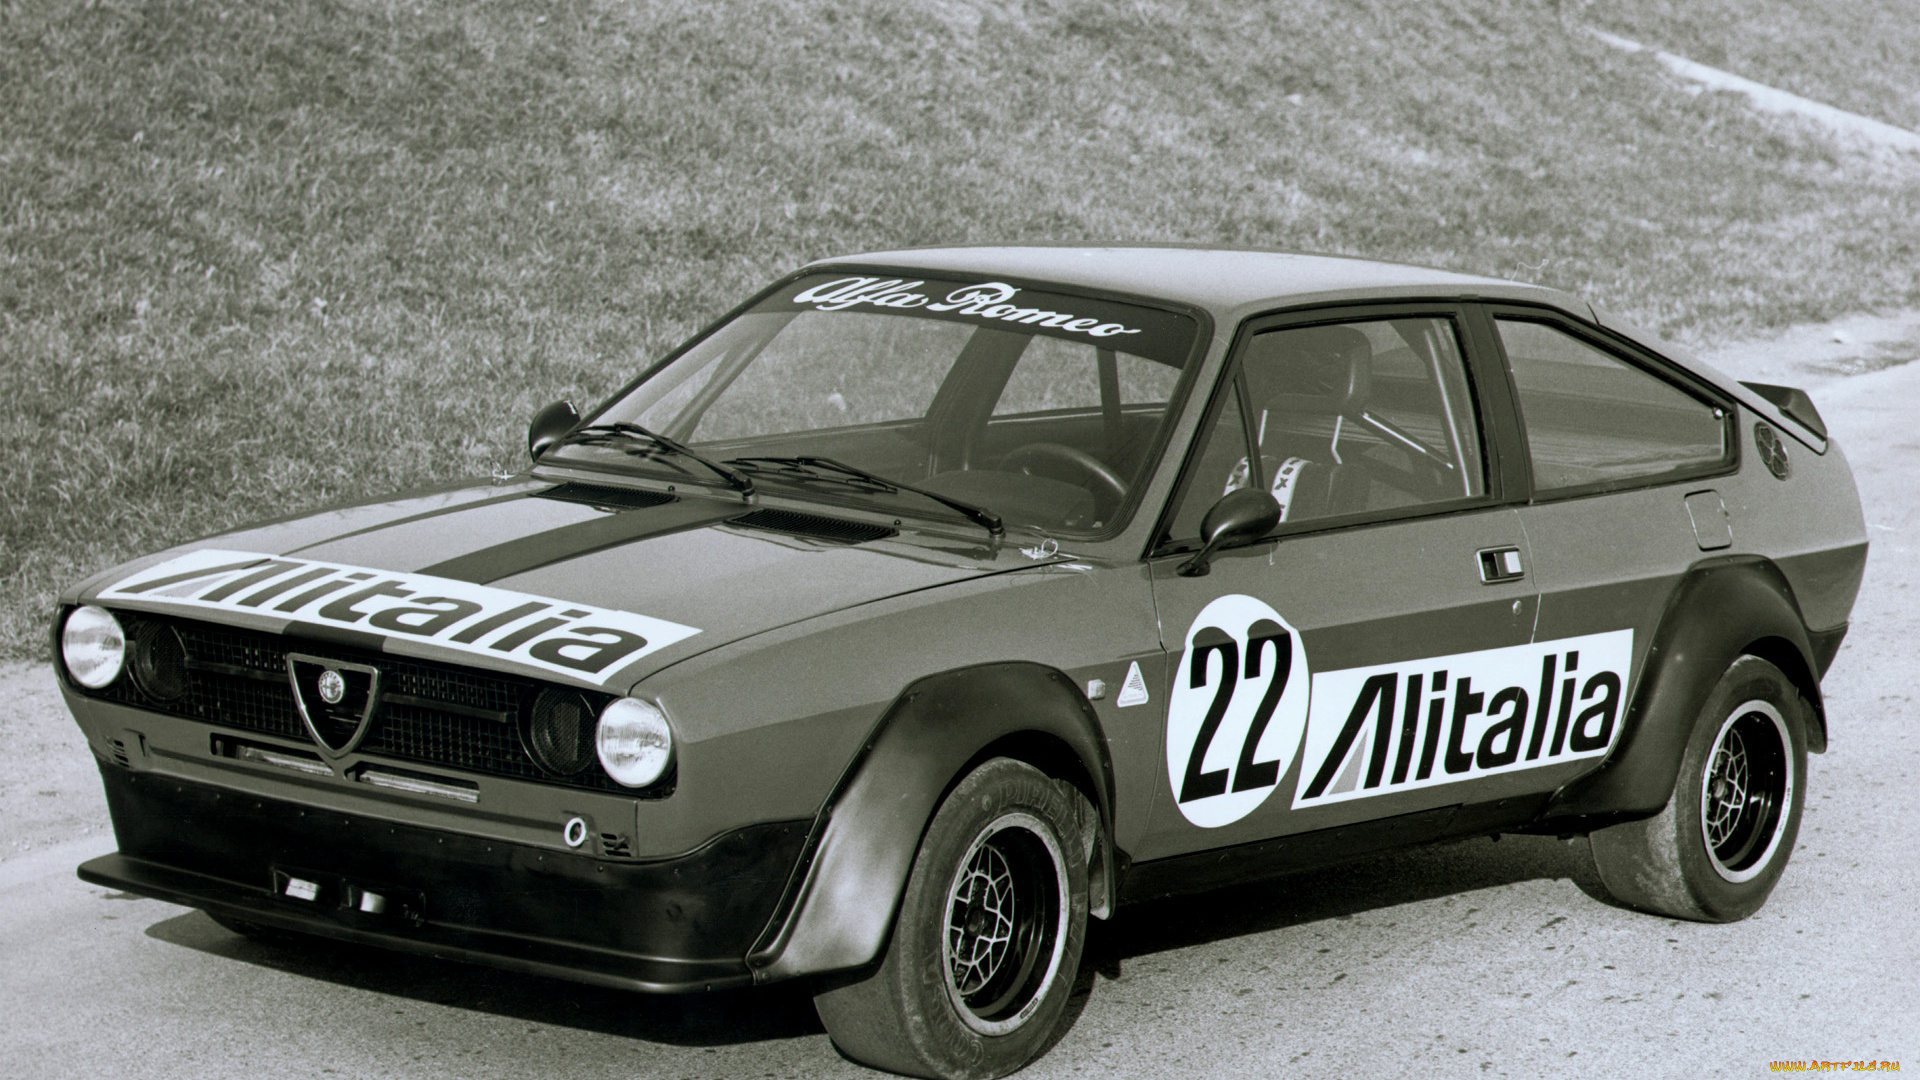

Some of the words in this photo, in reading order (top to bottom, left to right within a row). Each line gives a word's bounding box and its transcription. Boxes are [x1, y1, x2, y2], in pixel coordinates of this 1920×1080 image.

[793, 277, 929, 311] Alfa
[926, 282, 1141, 337] Romeo
[115, 558, 649, 675] Alitalia
[1178, 618, 1293, 804] 22
[1301, 650, 1622, 800] Alitalia
